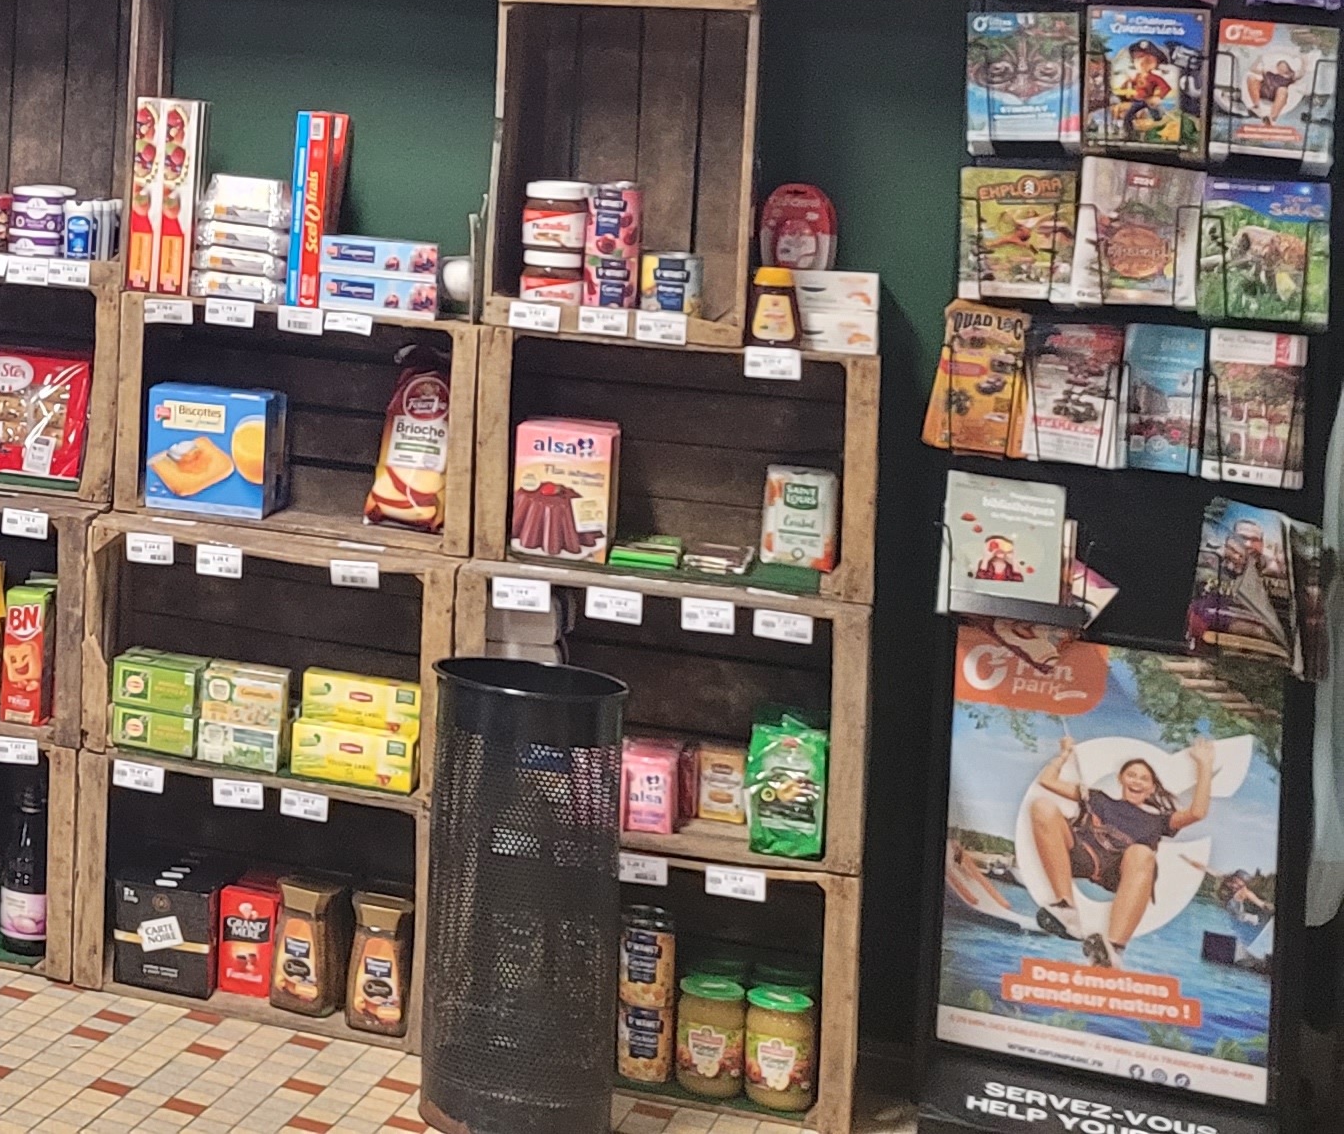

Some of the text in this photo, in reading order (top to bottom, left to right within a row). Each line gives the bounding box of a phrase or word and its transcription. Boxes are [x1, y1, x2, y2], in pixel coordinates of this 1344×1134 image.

[177, 403, 223, 420] Biscottes
[395, 421, 446, 439] Brioche
[533, 435, 578, 456] alsa
[8, 604, 41, 635] BN
[1015, 654, 1075, 682] Fn
[1011, 677, 1058, 695] park
[629, 788, 662, 804] alsa
[144, 921, 175, 940] CARTE
[146, 929, 180, 946] NOIRE
[1031, 965, 1169, 998] Des émotions
[1010, 983, 1191, 1019] grandeur nature !
[966, 1094, 1048, 1123] HELP
[984, 1082, 1218, 1134] SERVEZ-VOUS
